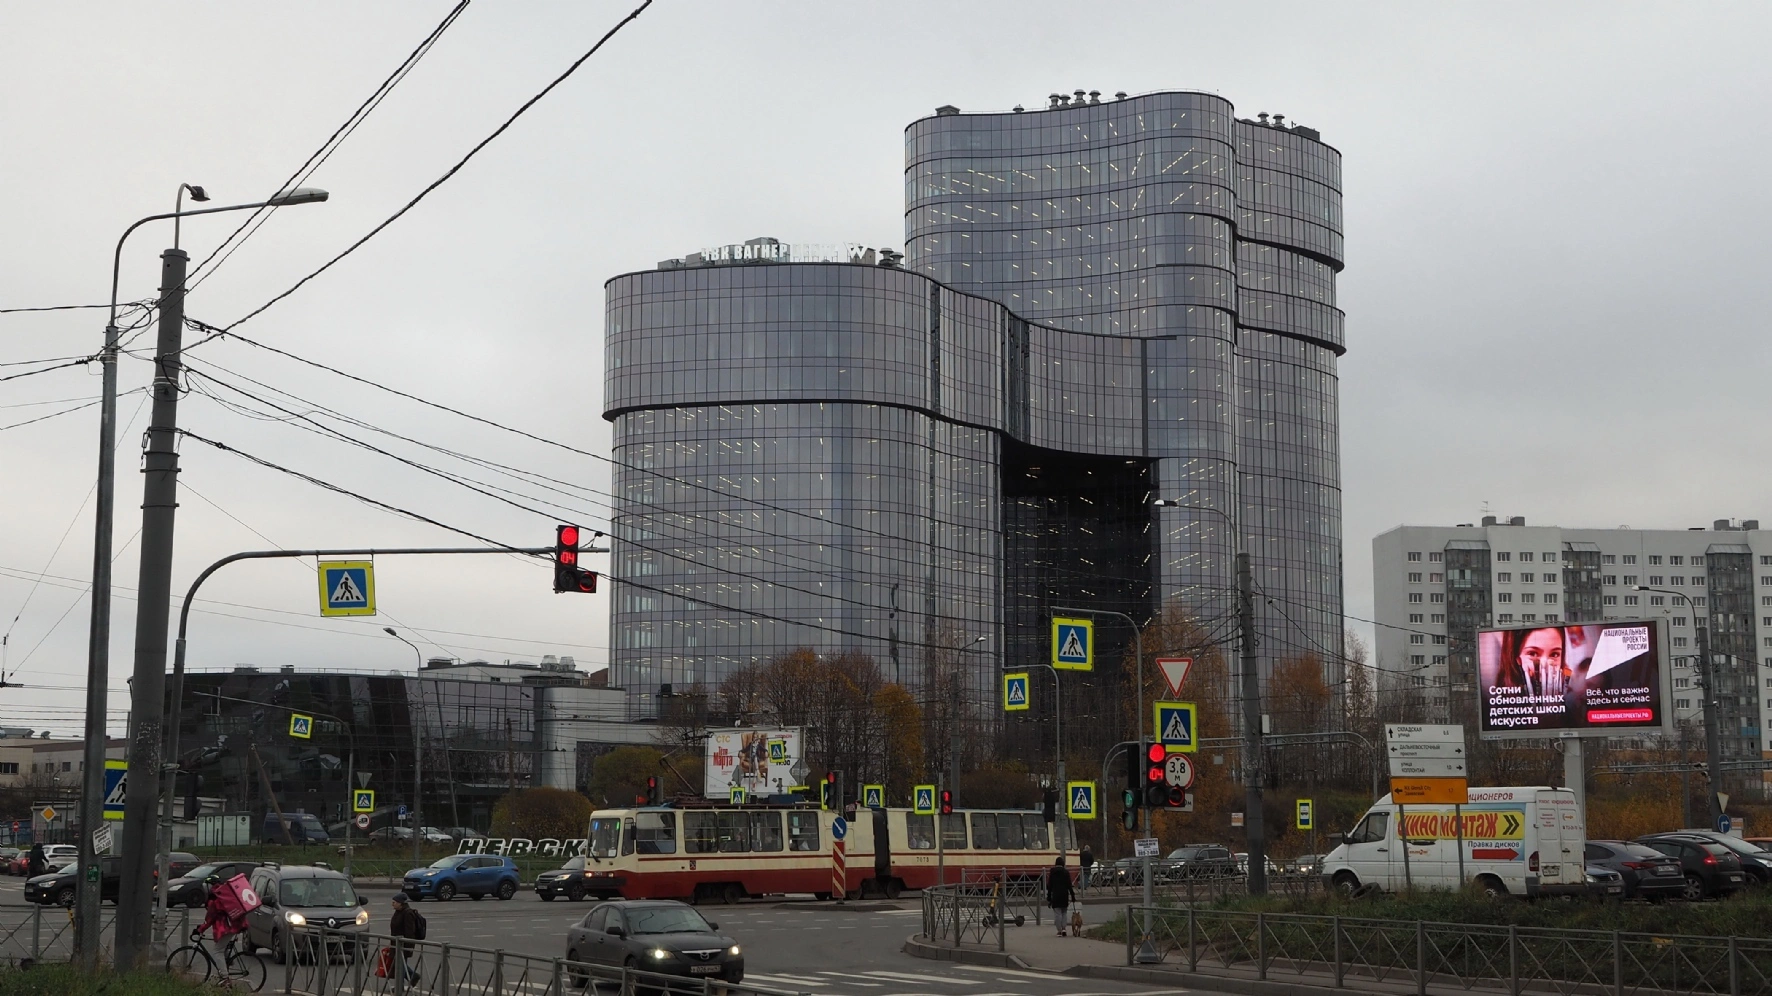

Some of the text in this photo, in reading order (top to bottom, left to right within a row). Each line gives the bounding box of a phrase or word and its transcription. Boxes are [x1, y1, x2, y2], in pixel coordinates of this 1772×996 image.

[701, 247, 729, 261] ЧВК
[734, 244, 788, 260] ВАГНЕР
[560, 551, 575, 564] 04
[1603, 627, 1647, 637] НАЦИОНАЛЬНЫЕ
[1621, 636, 1647, 644] ПРОЕКТЫ
[1626, 643, 1648, 651] РОССИИ
[1488, 685, 1522, 695] Сотни
[1586, 688, 1604, 697] Всё,
[1621, 686, 1650, 695] важно
[1489, 693, 1565, 705] обновлённых
[1586, 697, 1611, 706] здесь
[1620, 694, 1651, 703] сейчас
[1489, 705, 1566, 717] детских школ
[1490, 716, 1539, 727] искусств
[1149, 768, 1163, 780] 04
[457, 838, 586, 857] НЕВСК
[1468, 841, 1493, 849] Правка
